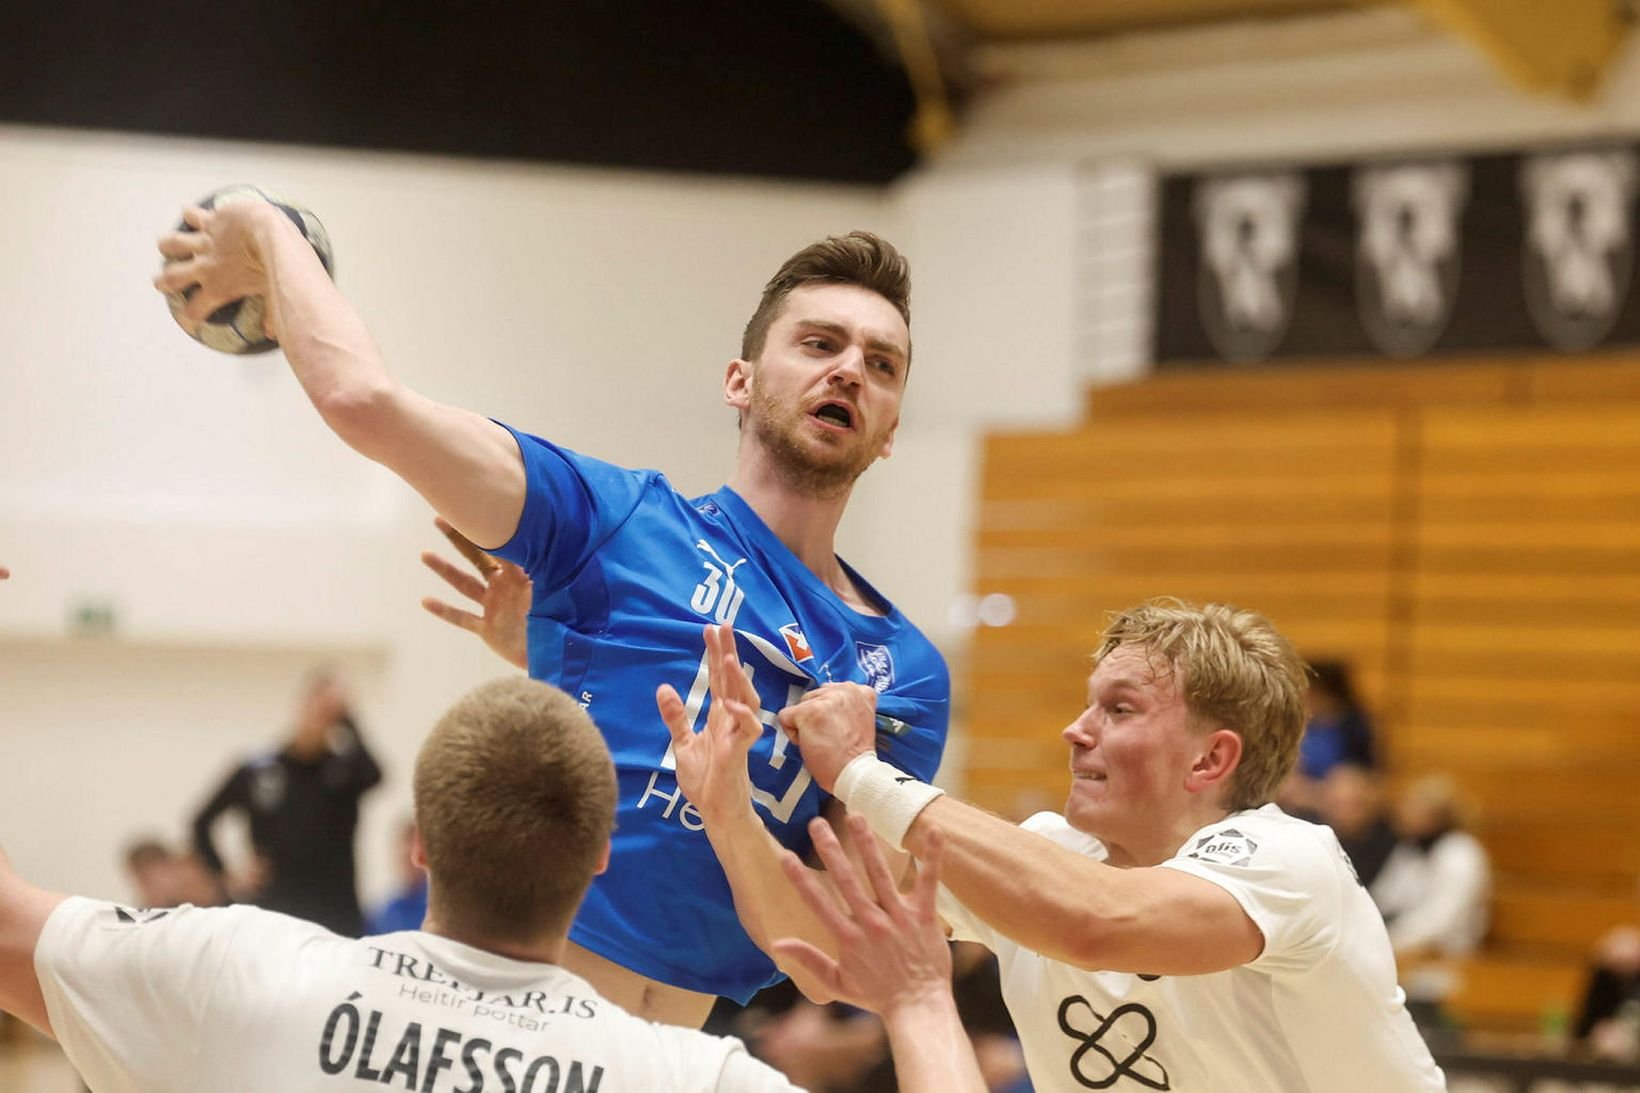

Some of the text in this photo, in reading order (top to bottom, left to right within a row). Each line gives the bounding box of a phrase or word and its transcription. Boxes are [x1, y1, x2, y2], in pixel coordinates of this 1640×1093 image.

[691, 561, 745, 627] 30
[1205, 842, 1242, 854] olis
[399, 983, 550, 1031] Heitir pottar
